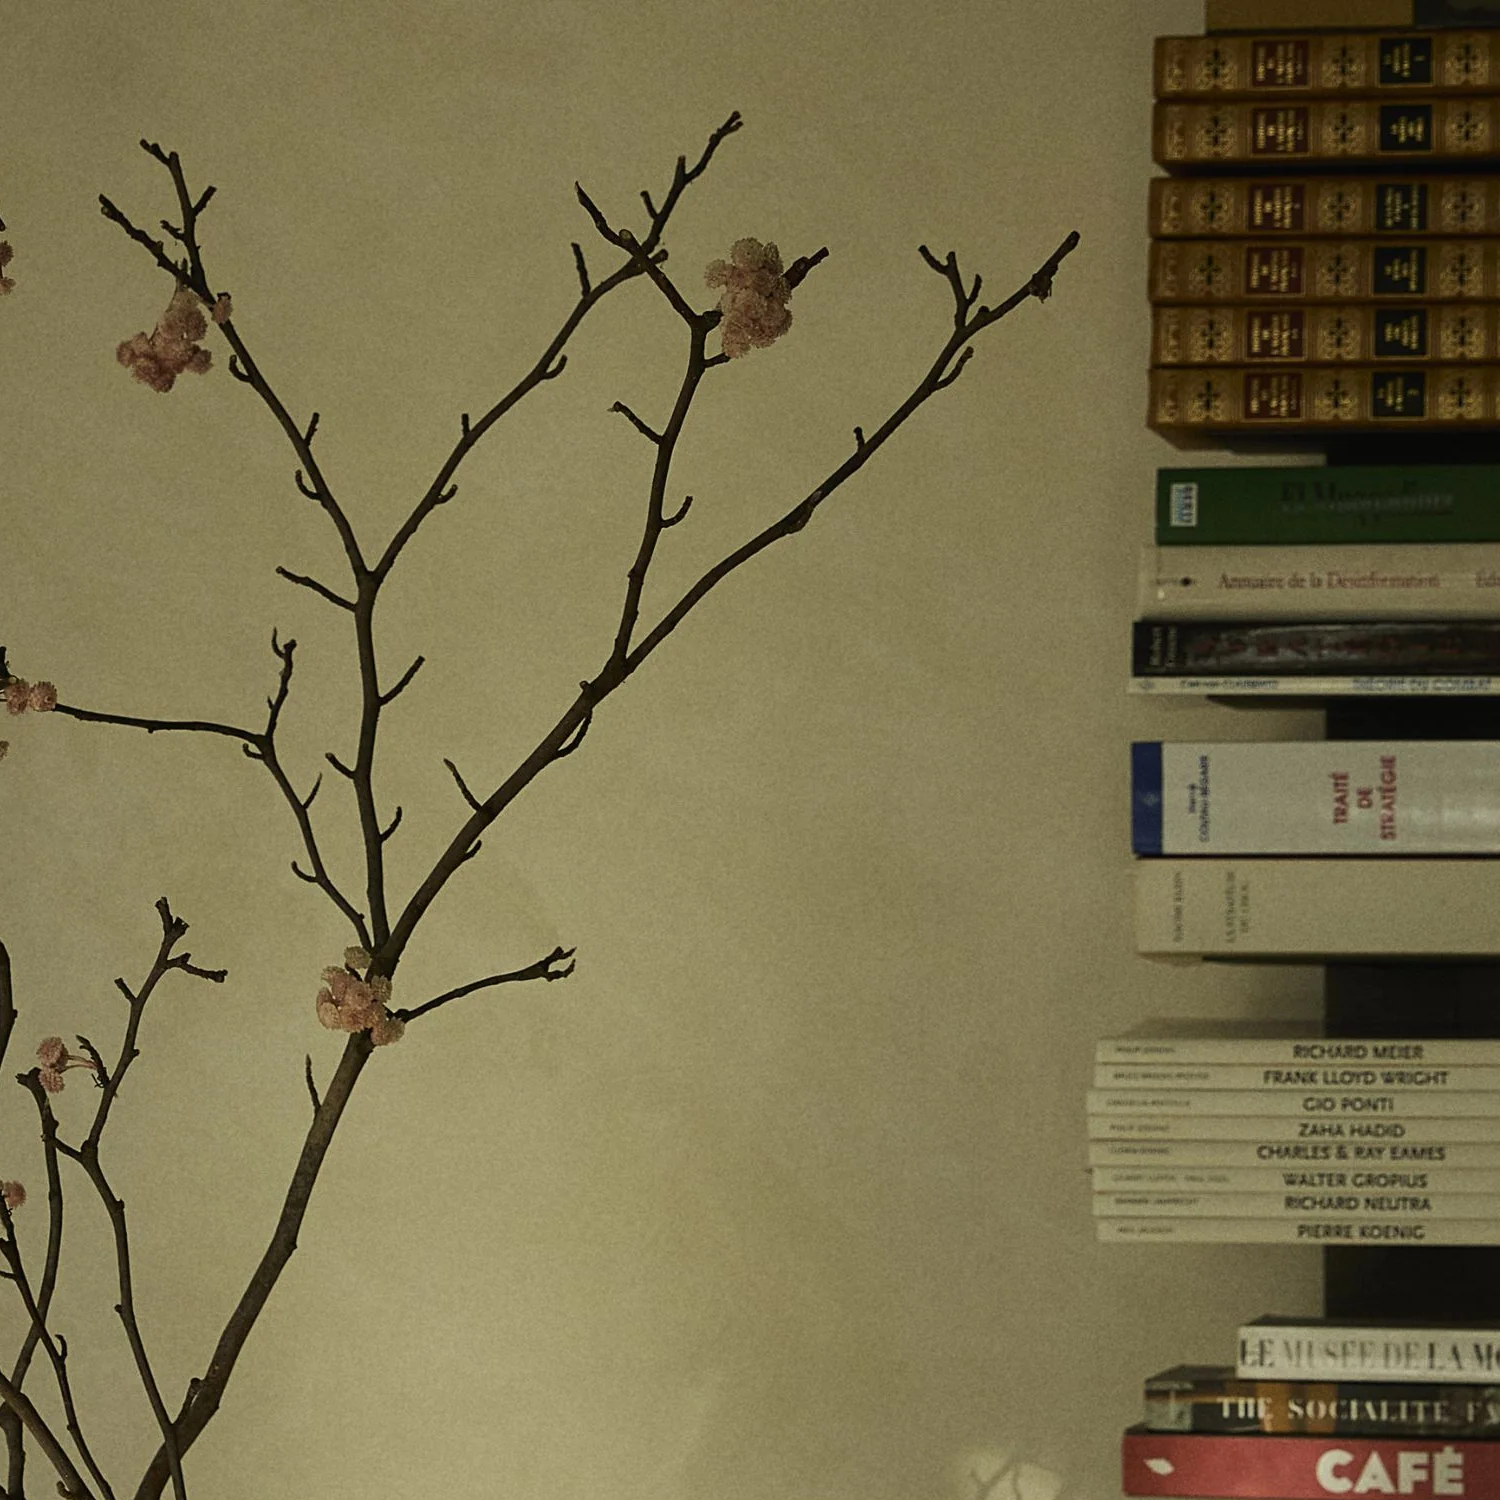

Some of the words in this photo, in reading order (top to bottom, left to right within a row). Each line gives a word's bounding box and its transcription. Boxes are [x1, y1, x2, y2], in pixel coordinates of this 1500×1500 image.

[1330, 771, 1349, 824] TRAITÉ
[1357, 787, 1373, 808] DE
[1377, 755, 1397, 840] STRATÉGIE
[1293, 1044, 1368, 1060] RICHARD
[1372, 1045, 1425, 1060] MEIER
[1263, 1070, 1318, 1086] FRANK
[1322, 1071, 1377, 1086] LLOYD
[1380, 1071, 1449, 1086] WRIGHT
[1302, 1097, 1336, 1112] GIO
[1340, 1097, 1395, 1112] PONTI
[1298, 1123, 1345, 1138] ZAHA
[1350, 1124, 1406, 1139] HADID
[1257, 1145, 1330, 1161] CHARLES
[1335, 1145, 1349, 1161] &
[1353, 1146, 1385, 1160] RAY
[1389, 1146, 1446, 1161] EAMES
[1282, 1173, 1347, 1188] WALTER
[1351, 1173, 1429, 1189] GROPIUS
[1284, 1195, 1360, 1211] RICHARD
[1363, 1196, 1432, 1212] NEUTRA
[1297, 1224, 1353, 1239] PIERRE
[1358, 1225, 1426, 1240] KOENIG
[1240, 1338, 1275, 1368] LE
[1382, 1341, 1422, 1371] DE
[1426, 1342, 1464, 1372] LA
[1216, 1397, 1273, 1420] THE
[1287, 1398, 1450, 1423] SOCIALITE
[1315, 1446, 1465, 1496] CAFÉ
